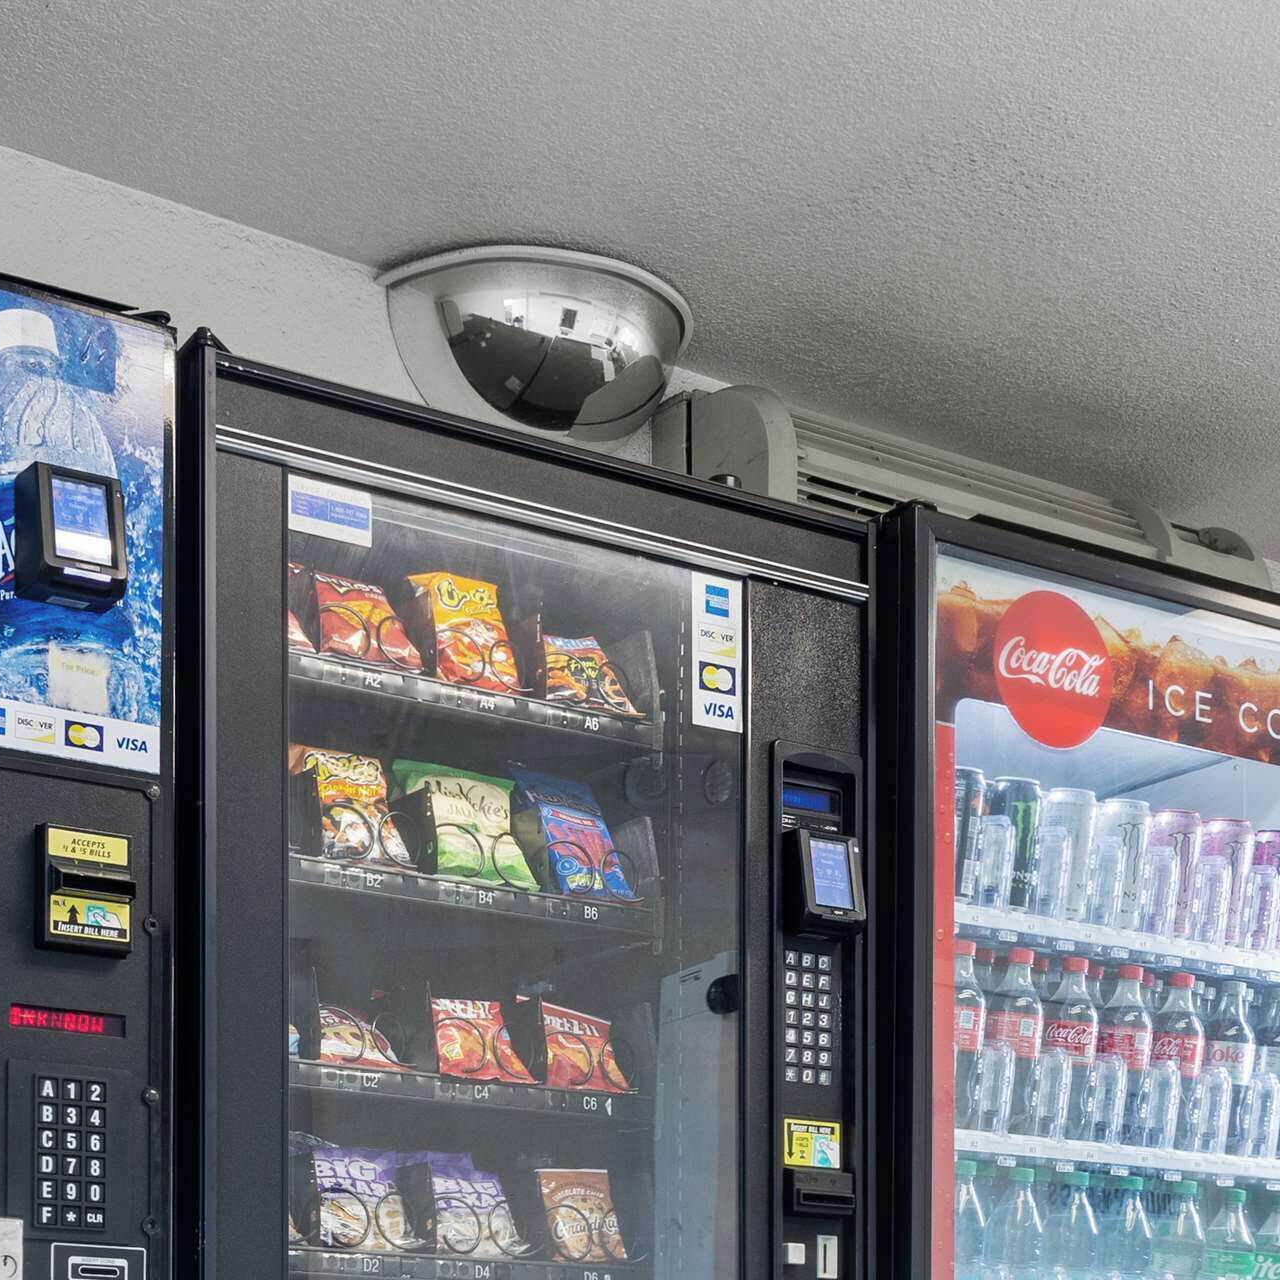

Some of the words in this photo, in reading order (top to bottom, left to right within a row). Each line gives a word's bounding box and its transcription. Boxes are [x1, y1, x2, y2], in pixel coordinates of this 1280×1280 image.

[998, 634, 1106, 699] Coca-Cola
[364, 674, 382, 689] A2
[479, 697, 496, 711] A4
[1147, 679, 1214, 724] ICE
[703, 702, 736, 722] VISA
[584, 717, 600, 731] A6
[116, 736, 149, 753] VISA
[71, 838, 106, 850] ACCEPTS
[89, 848, 112, 859] BILLS
[366, 875, 381, 889] B2
[478, 891, 493, 905] B4
[584, 906, 599, 920] B6
[57, 921, 82, 934] INSERT
[83, 924, 99, 936] BILL
[100, 928, 119, 938] HERE
[363, 1075, 379, 1088] C2
[42, 1081, 54, 1097] A
[67, 1084, 76, 1099] 1
[90, 1085, 101, 1101] 2
[474, 1086, 489, 1099] C4
[583, 1097, 598, 1110] C6
[42, 1106, 54, 1122] B
[67, 1108, 77, 1124] 3
[90, 1110, 101, 1126] 4
[42, 1131, 53, 1148] C
[67, 1133, 77, 1149] 5
[90, 1135, 101, 1151] 6
[42, 1157, 54, 1173] D
[67, 1159, 76, 1175] 7
[90, 1160, 101, 1176] 8
[315, 1159, 378, 1182] BIG
[42, 1182, 52, 1198] E
[67, 1184, 76, 1200] 9
[90, 1185, 100, 1201] 0
[42, 1207, 52, 1223] F
[86, 1212, 103, 1223] CLR
[363, 1260, 379, 1273] D2
[475, 1265, 490, 1279] D4
